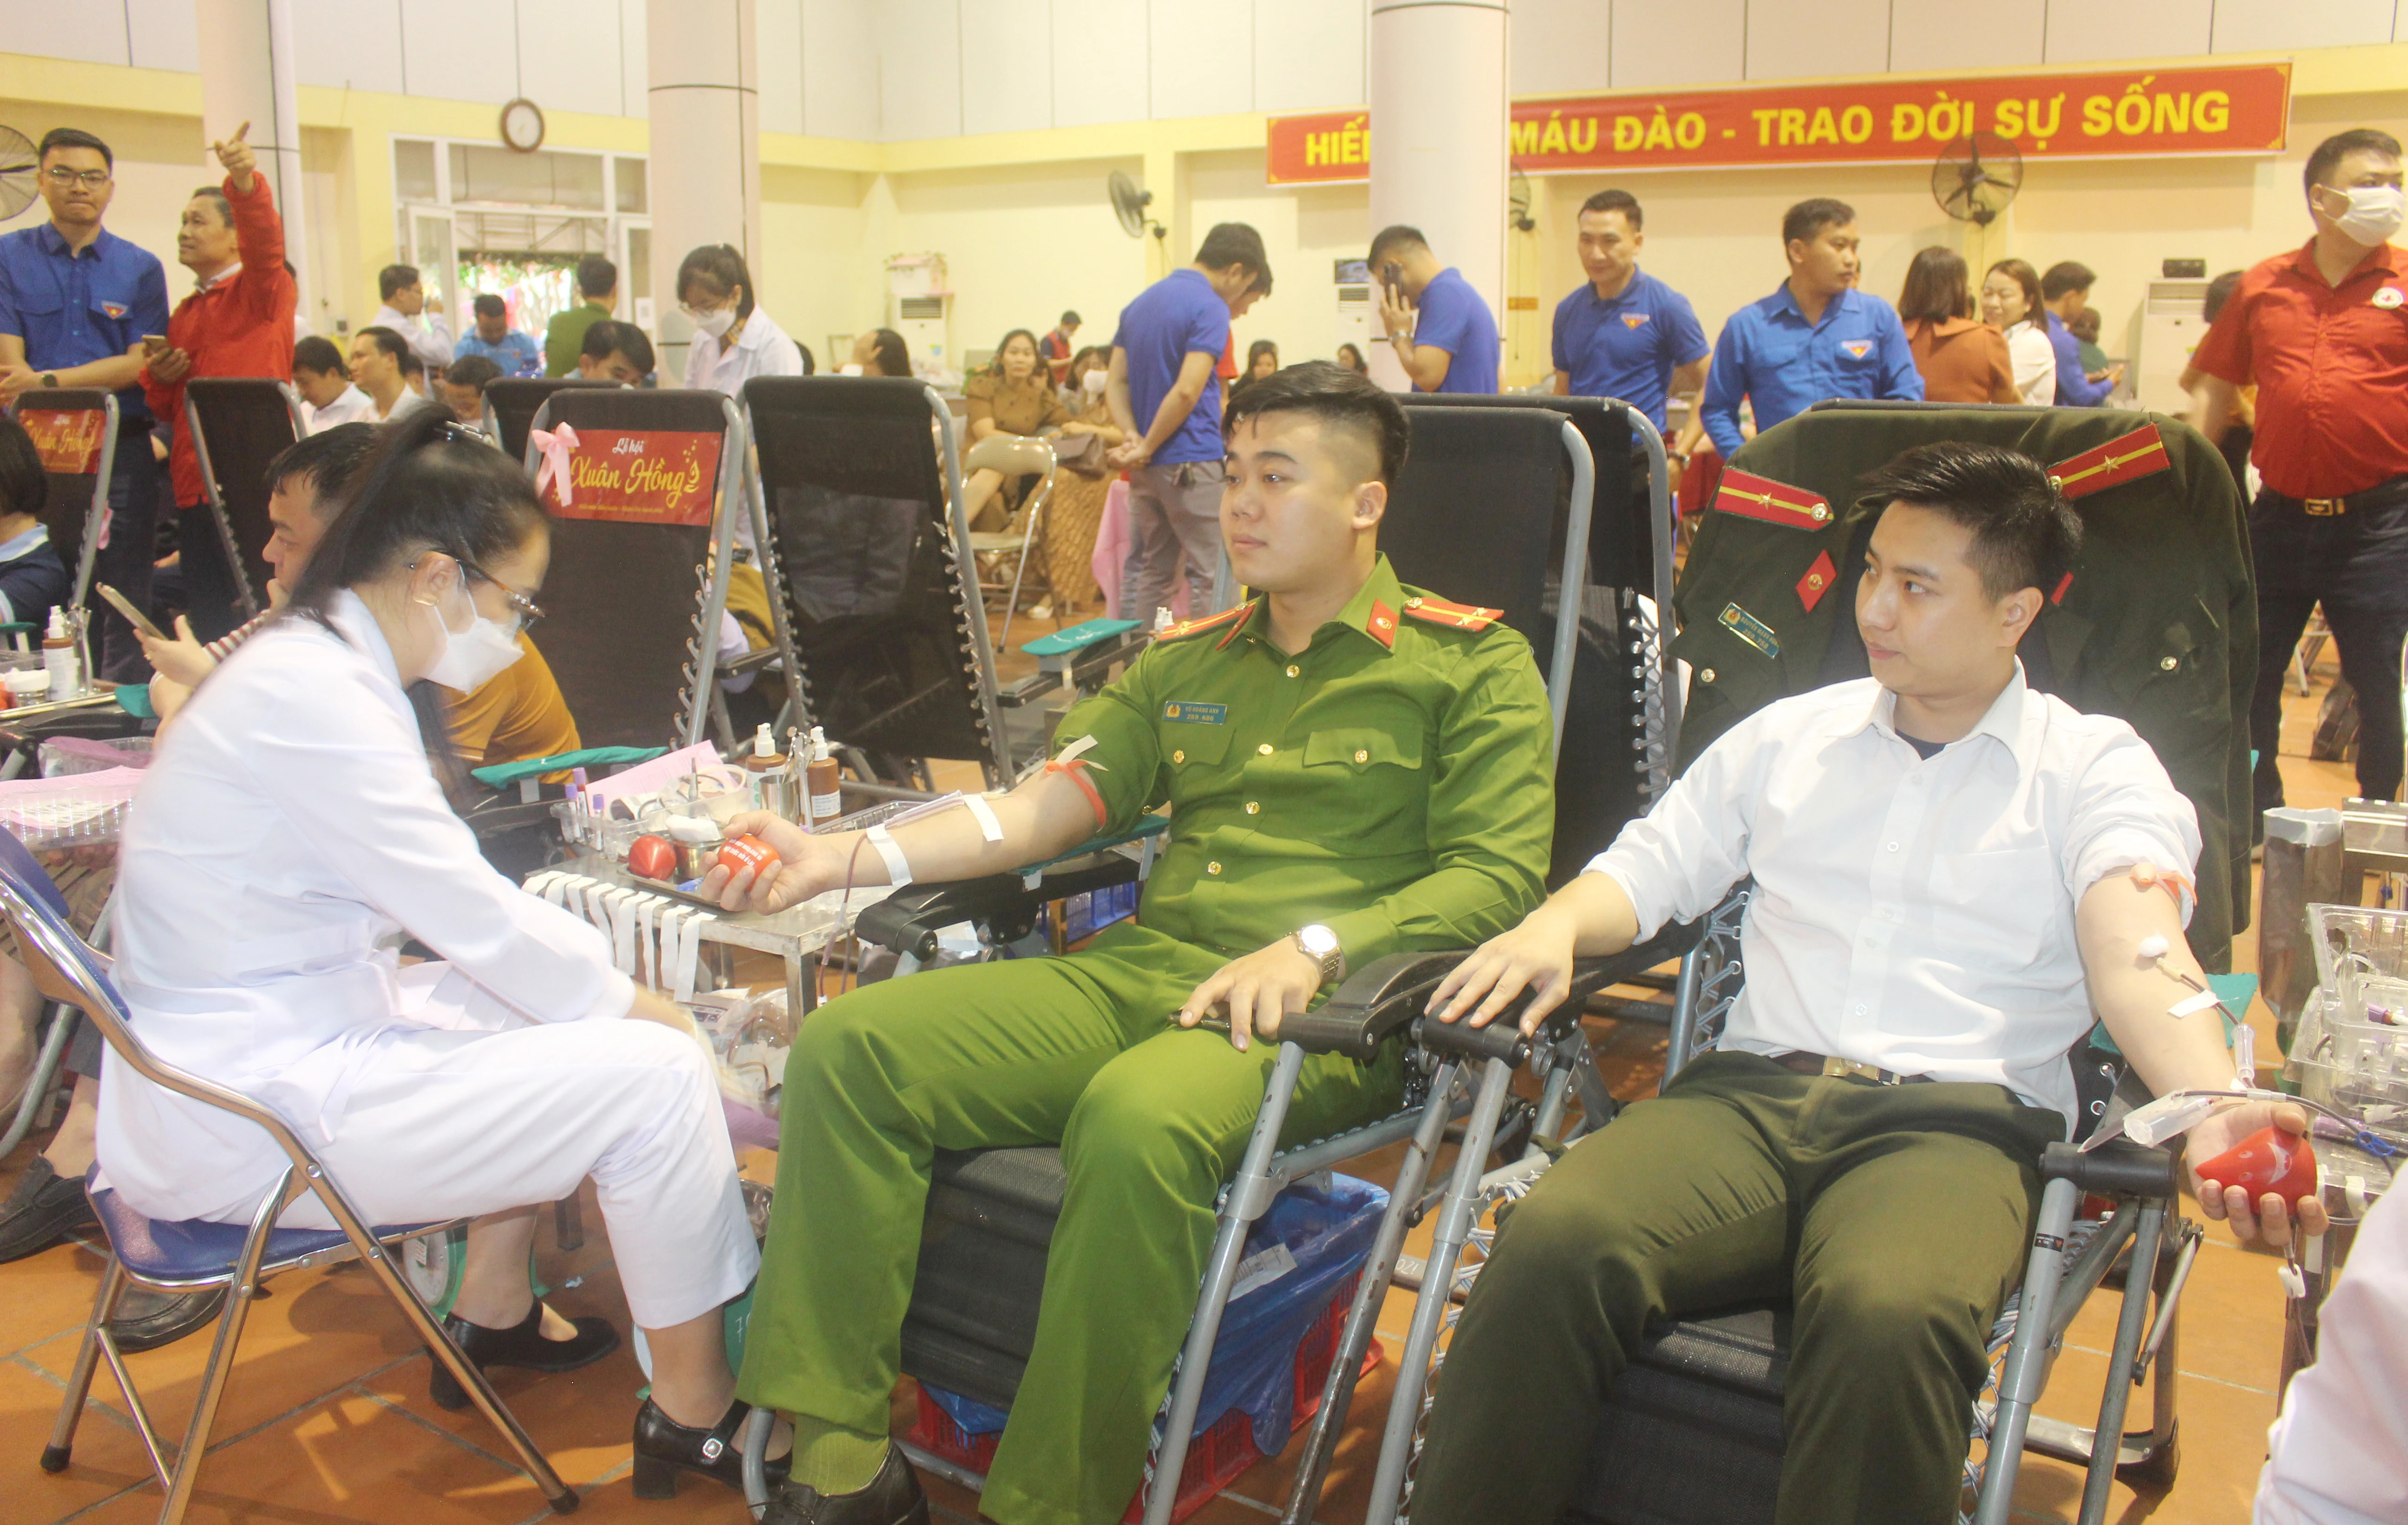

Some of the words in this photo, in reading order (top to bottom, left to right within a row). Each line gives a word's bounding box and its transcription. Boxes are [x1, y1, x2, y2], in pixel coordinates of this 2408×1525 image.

[1510, 110, 1597, 156] MÁU
[1614, 105, 1706, 151] ĐÀO
[1752, 105, 1873, 147] TRAO
[1891, 90, 1975, 143] ĐỜI
[1994, 91, 2066, 150] SỰ
[2082, 75, 2231, 137] SỐNG
[612, 437, 628, 455] Lễ
[629, 438, 645, 455] hội
[571, 456, 622, 489] Xuân
[625, 457, 686, 508] Hồng
